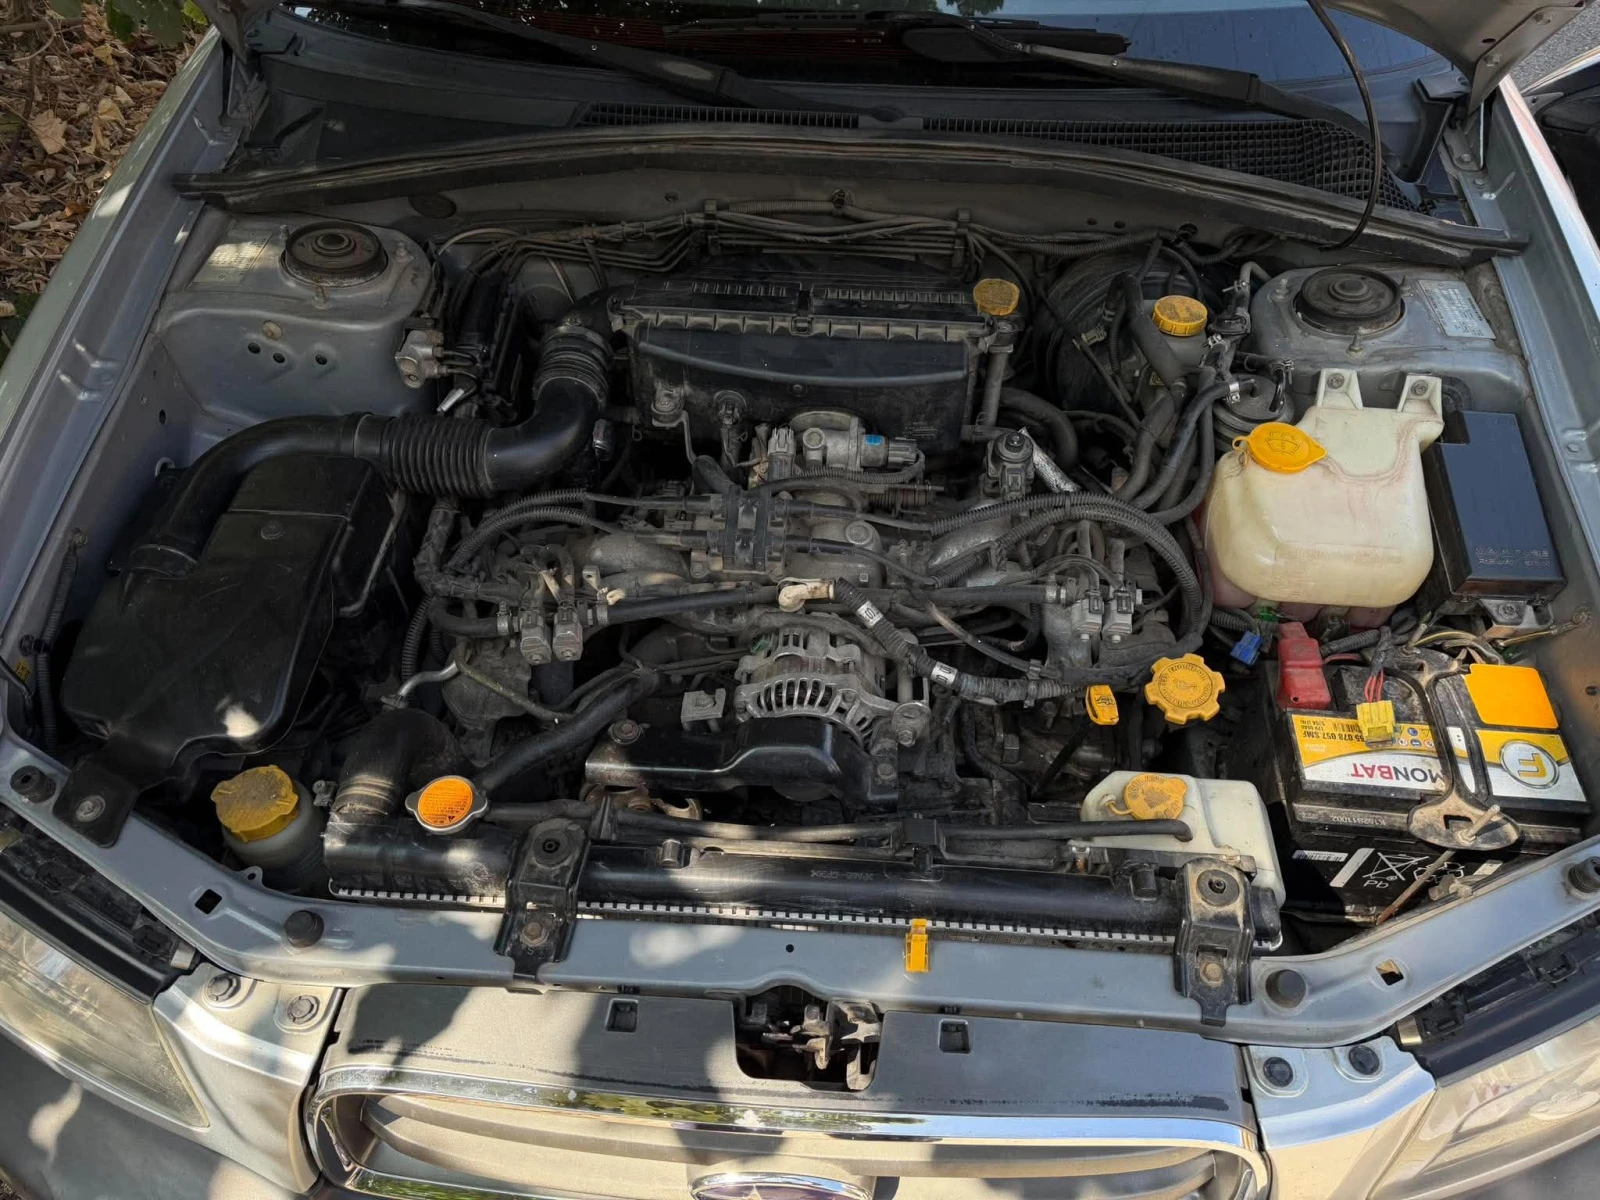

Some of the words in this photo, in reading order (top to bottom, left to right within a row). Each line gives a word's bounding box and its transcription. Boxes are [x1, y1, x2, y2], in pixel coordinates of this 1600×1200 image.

[1302, 730, 1320, 738] SMF
[1351, 762, 1445, 784] MONBAT
[1363, 880, 1389, 889] Pb
